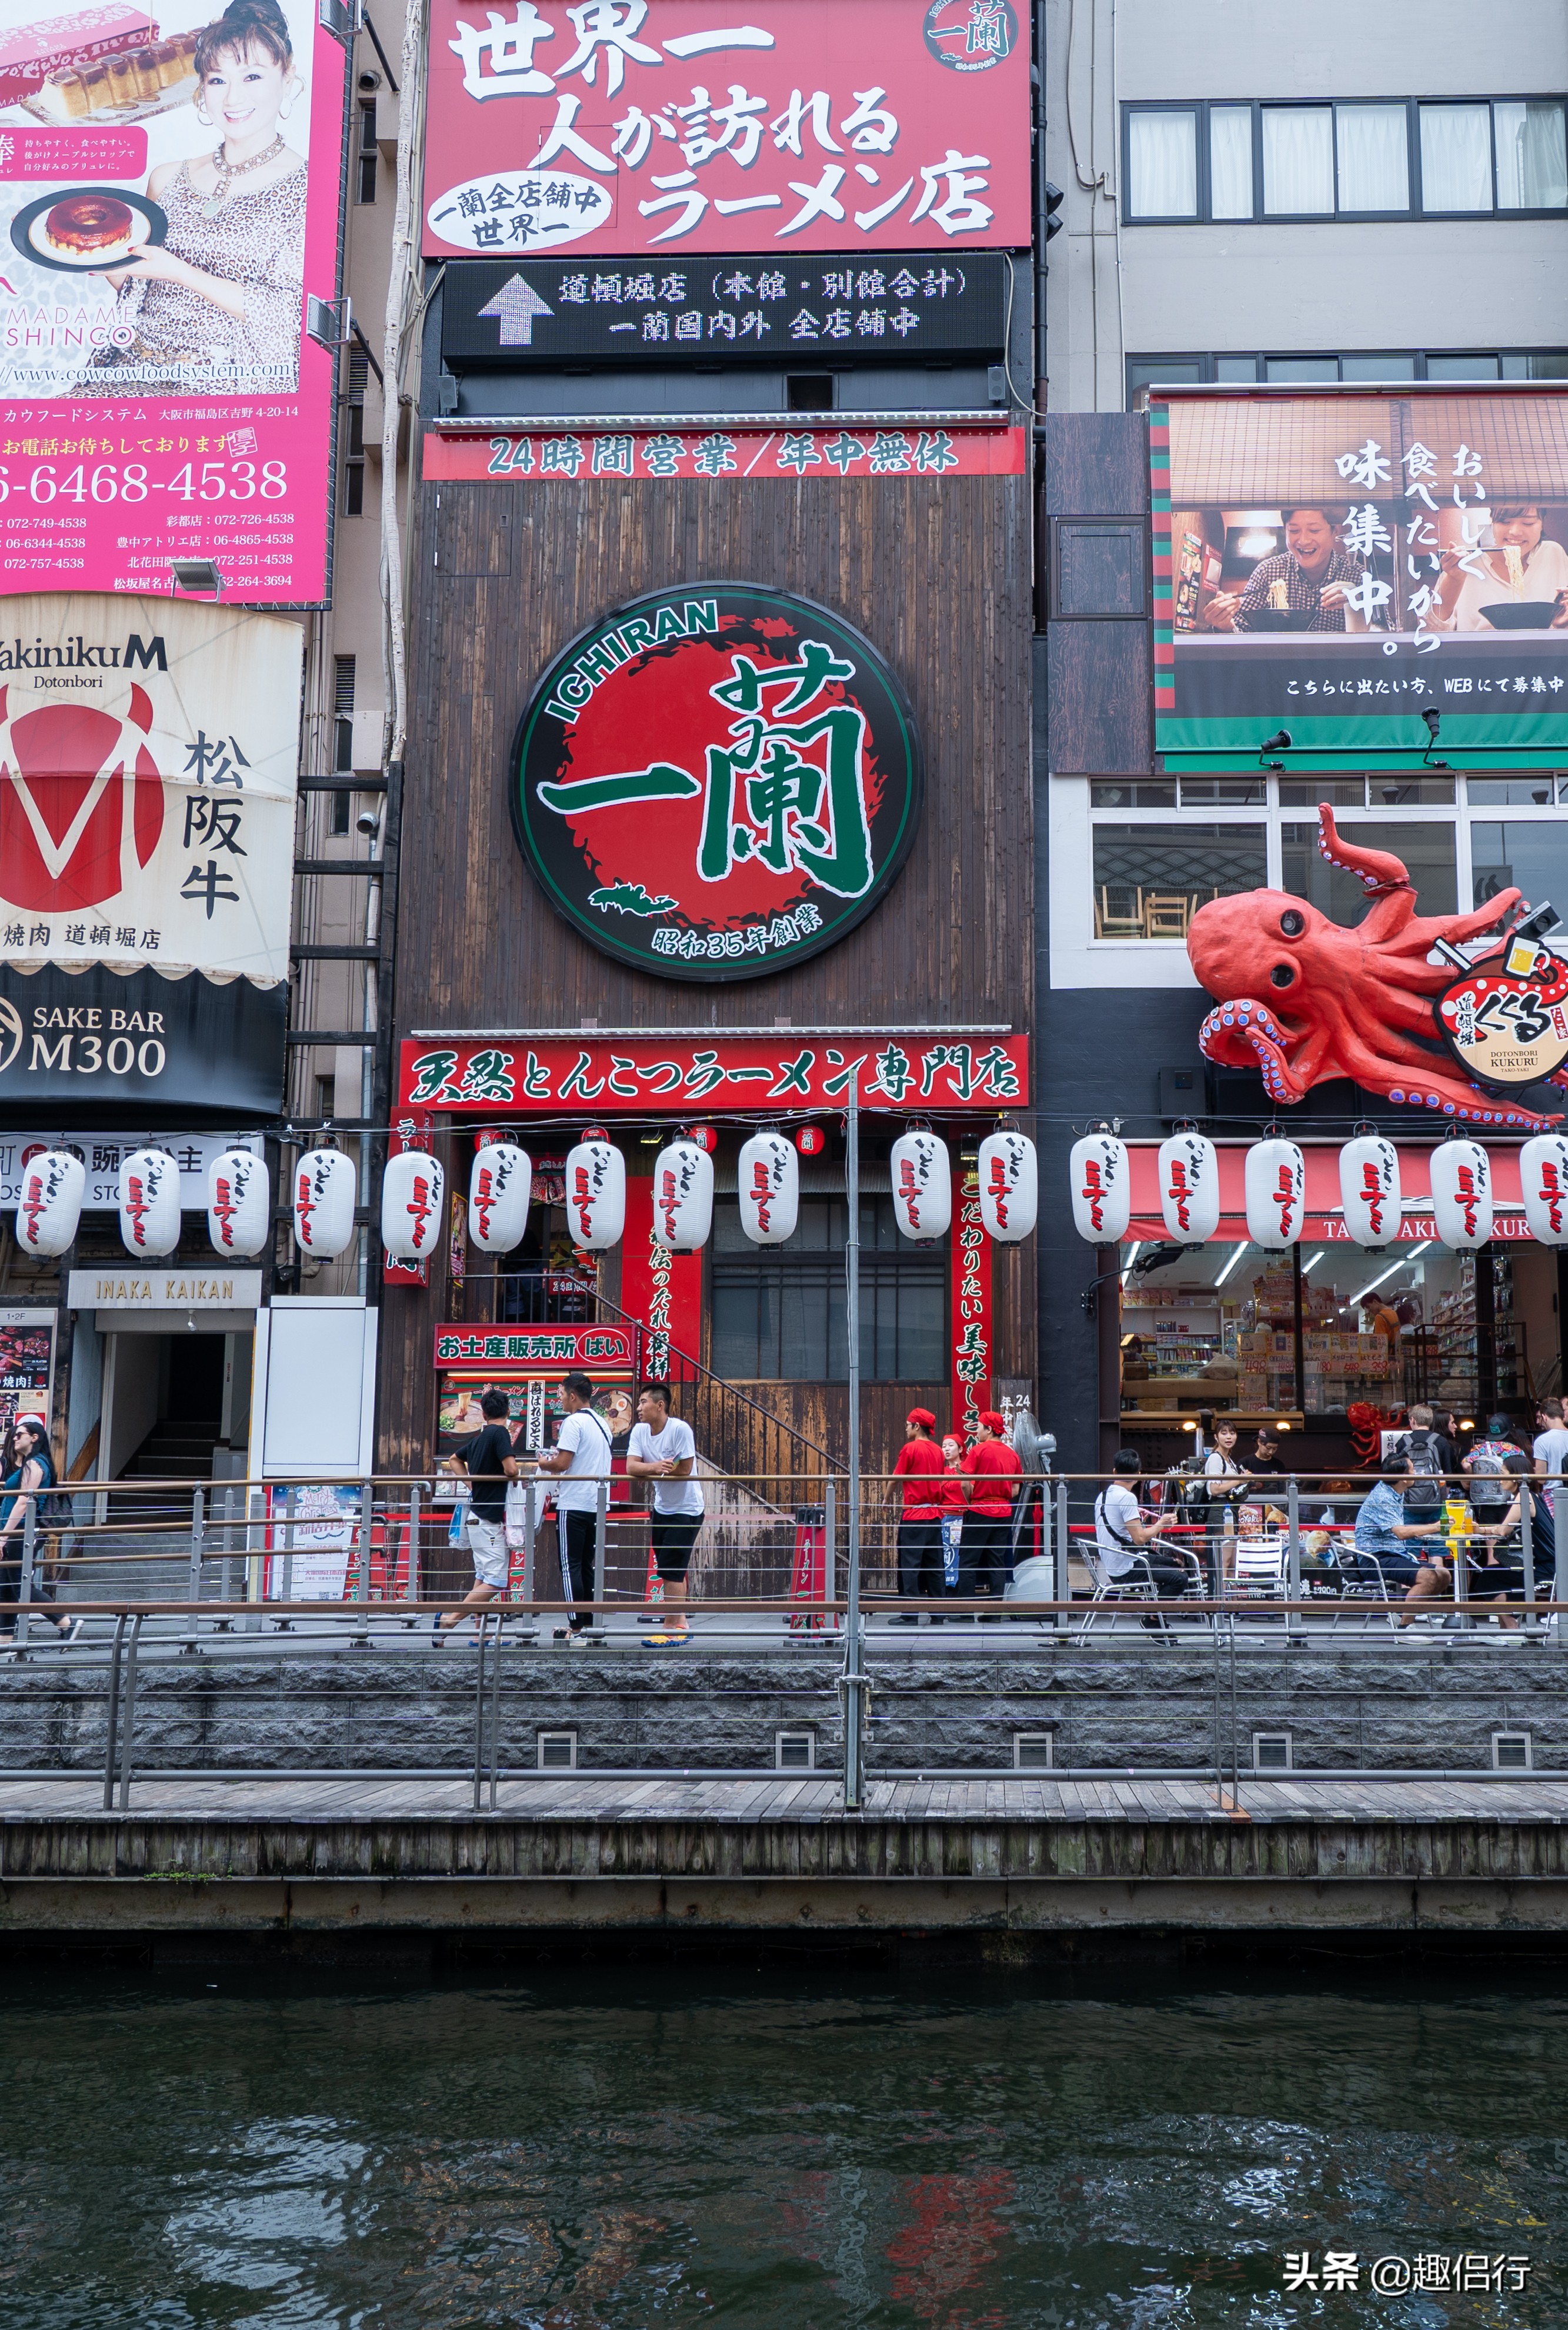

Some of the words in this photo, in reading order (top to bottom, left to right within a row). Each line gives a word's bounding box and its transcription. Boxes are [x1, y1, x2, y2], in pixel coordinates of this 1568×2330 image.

[928, 0, 1009, 56] 一蘭
[448, 0, 775, 101] 世界一
[25, 139, 131, 148] 持ちやすく、食べやすい。
[527, 85, 899, 173] 人が訪れる
[433, 181, 602, 223] 一蘭全店舗中
[638, 149, 994, 244] ラーメン店
[471, 215, 569, 248] 世界一
[558, 273, 687, 303] 道頓堀店
[7, 306, 136, 325] MADAME
[610, 309, 770, 340] 一蘭国内外
[789, 307, 919, 338] 全店舗中
[6, 326, 134, 347] SHINCO
[3, 408, 146, 423] カウフードシステム
[158, 407, 253, 421] 大阪市福島区吉野
[256, 406, 299, 418] 4-20-14
[2, 435, 229, 456] お電話お待ちしております
[1452, 444, 1486, 581] おいしく
[4, 558, 85, 569] 072-757-4538
[1400, 442, 1443, 654] 食べたいから
[123, 634, 168, 672] M
[545, 599, 719, 725] ICHIRAN
[34, 675, 103, 689] Dotonbori
[1444, 678, 1473, 694] WEB
[536, 641, 875, 898] 一蘭
[180, 730, 251, 920] 松阪牛
[2, 923, 51, 948] 焼肉
[64, 923, 161, 950] 道頓堀店
[652, 904, 823, 959] 昭和35年創業
[33, 1007, 102, 1029] SAKE
[110, 1009, 166, 1033] BAR
[1474, 993, 1552, 1043] くくる
[27, 1034, 166, 1077] M300
[1491, 1057, 1539, 1067] KUKURU
[409, 1042, 1022, 1104] 天然とんこつラーメン専門店
[96, 1280, 152, 1298] INAKA
[166, 1280, 233, 1298] KAIKAN
[438, 1336, 576, 1360] お土産販売所
[585, 1336, 625, 1357] ばい
[299, 1504, 340, 1518] Christmas
[305, 1491, 333, 1505] Merry
